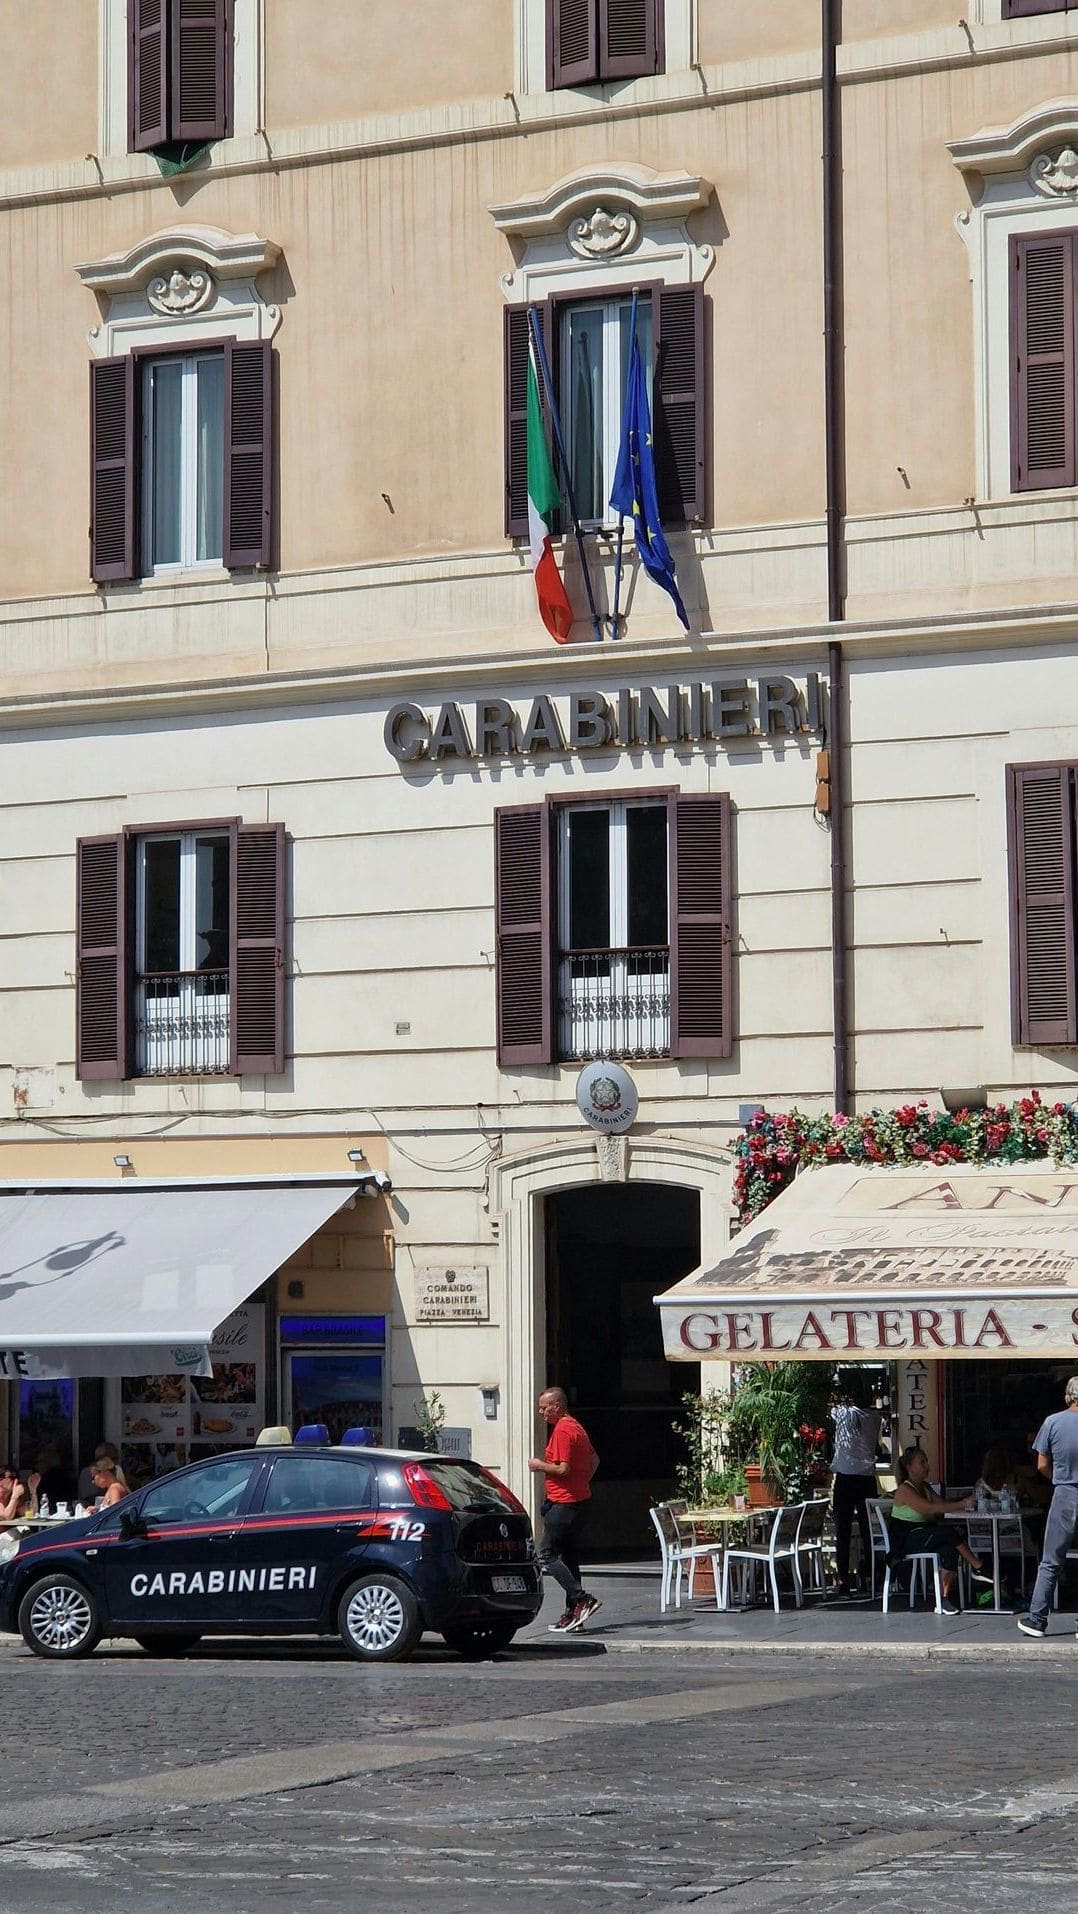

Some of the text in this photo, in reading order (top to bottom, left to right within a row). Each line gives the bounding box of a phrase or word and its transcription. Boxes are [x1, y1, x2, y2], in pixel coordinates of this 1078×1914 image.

[384, 671, 823, 761] CARABINIERI
[583, 1105, 634, 1125] CARABINIERI
[427, 1284, 473, 1293] COMANDO
[423, 1295, 477, 1305] CARABINIERI
[419, 1308, 482, 1317] PIAZZA VENEZIA
[680, 1308, 1017, 1352] GELATERIA
[389, 1520, 426, 1541] 112
[130, 1566, 317, 1597] CARABINIERI
